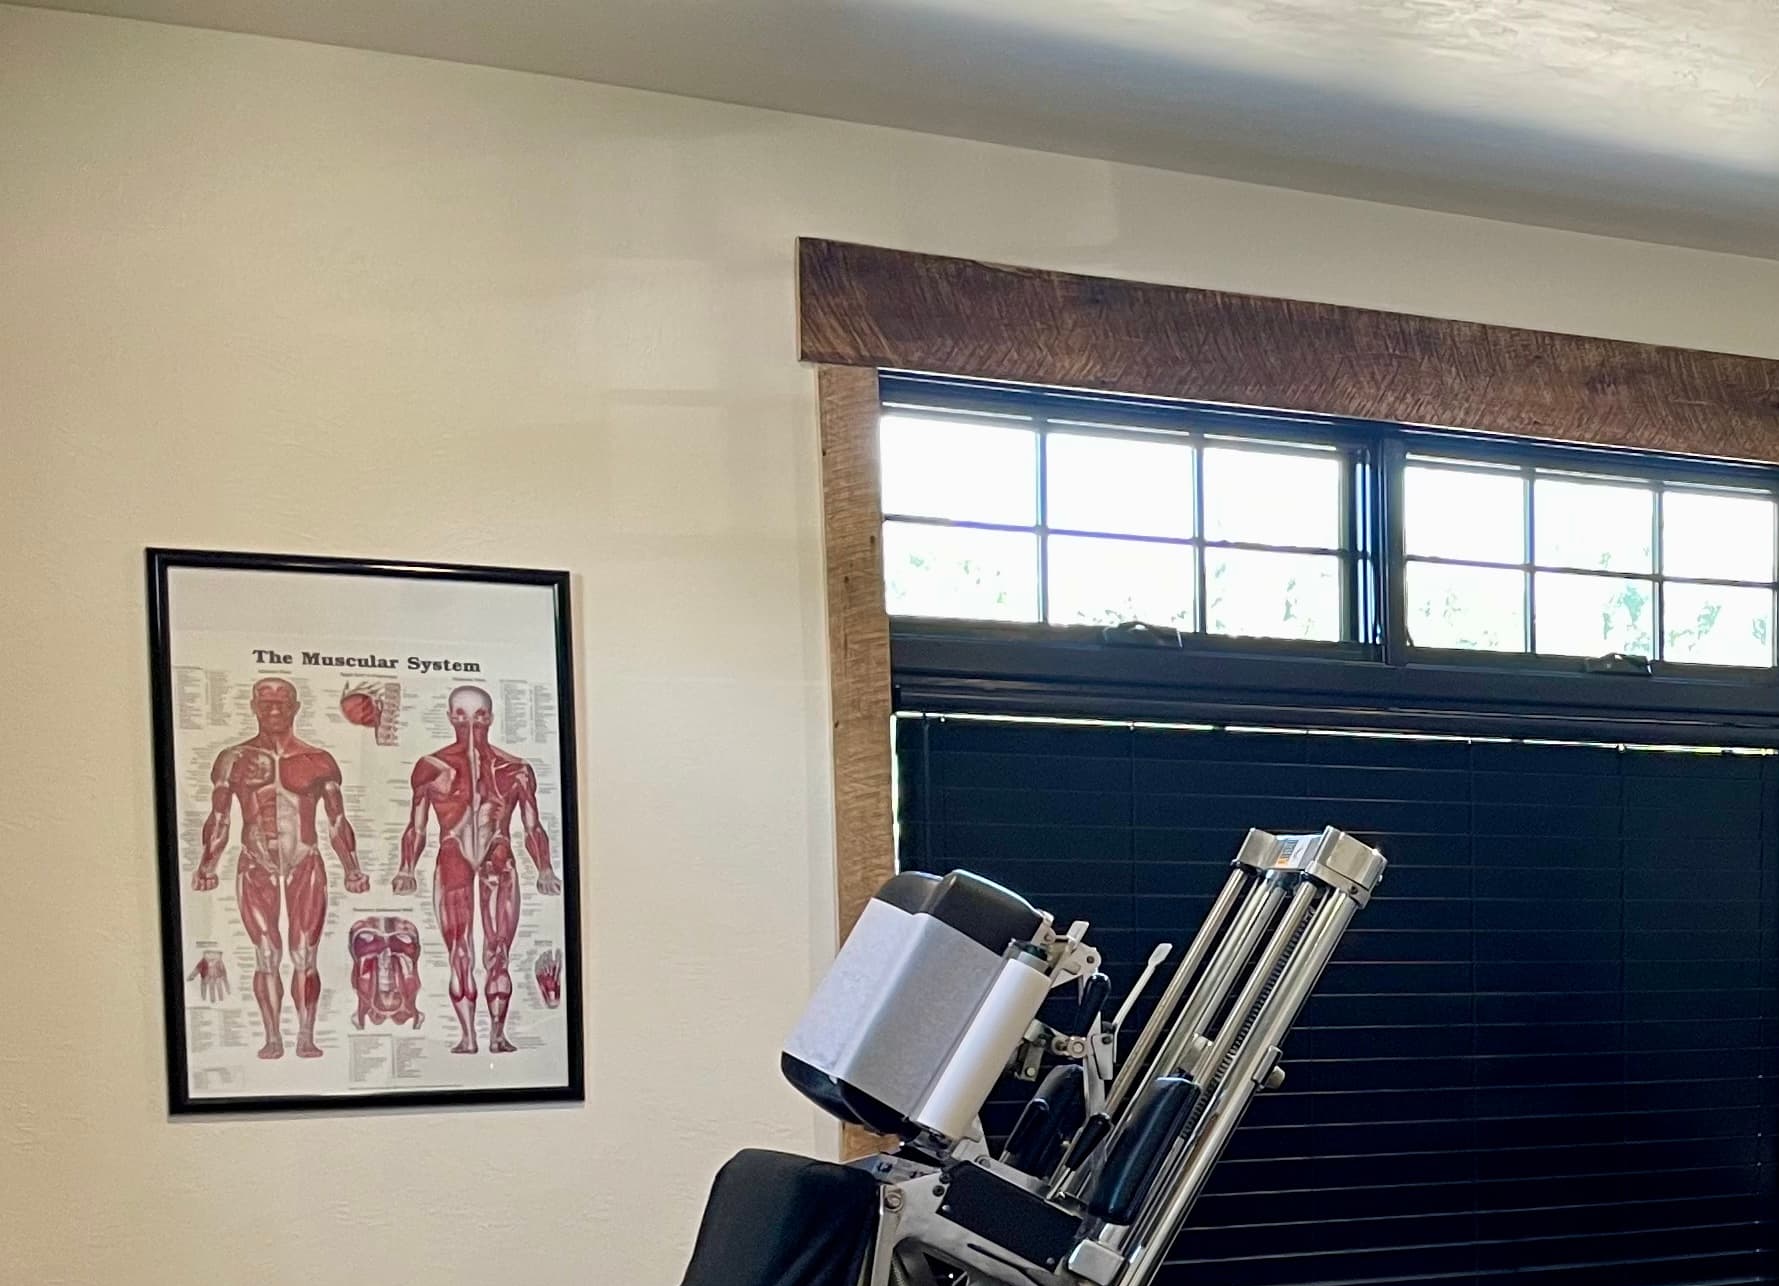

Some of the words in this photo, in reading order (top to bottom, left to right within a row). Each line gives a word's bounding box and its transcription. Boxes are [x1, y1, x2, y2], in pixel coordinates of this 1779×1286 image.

[252, 650, 293, 665] The
[301, 652, 398, 669] Muscular
[407, 657, 481, 673] System
